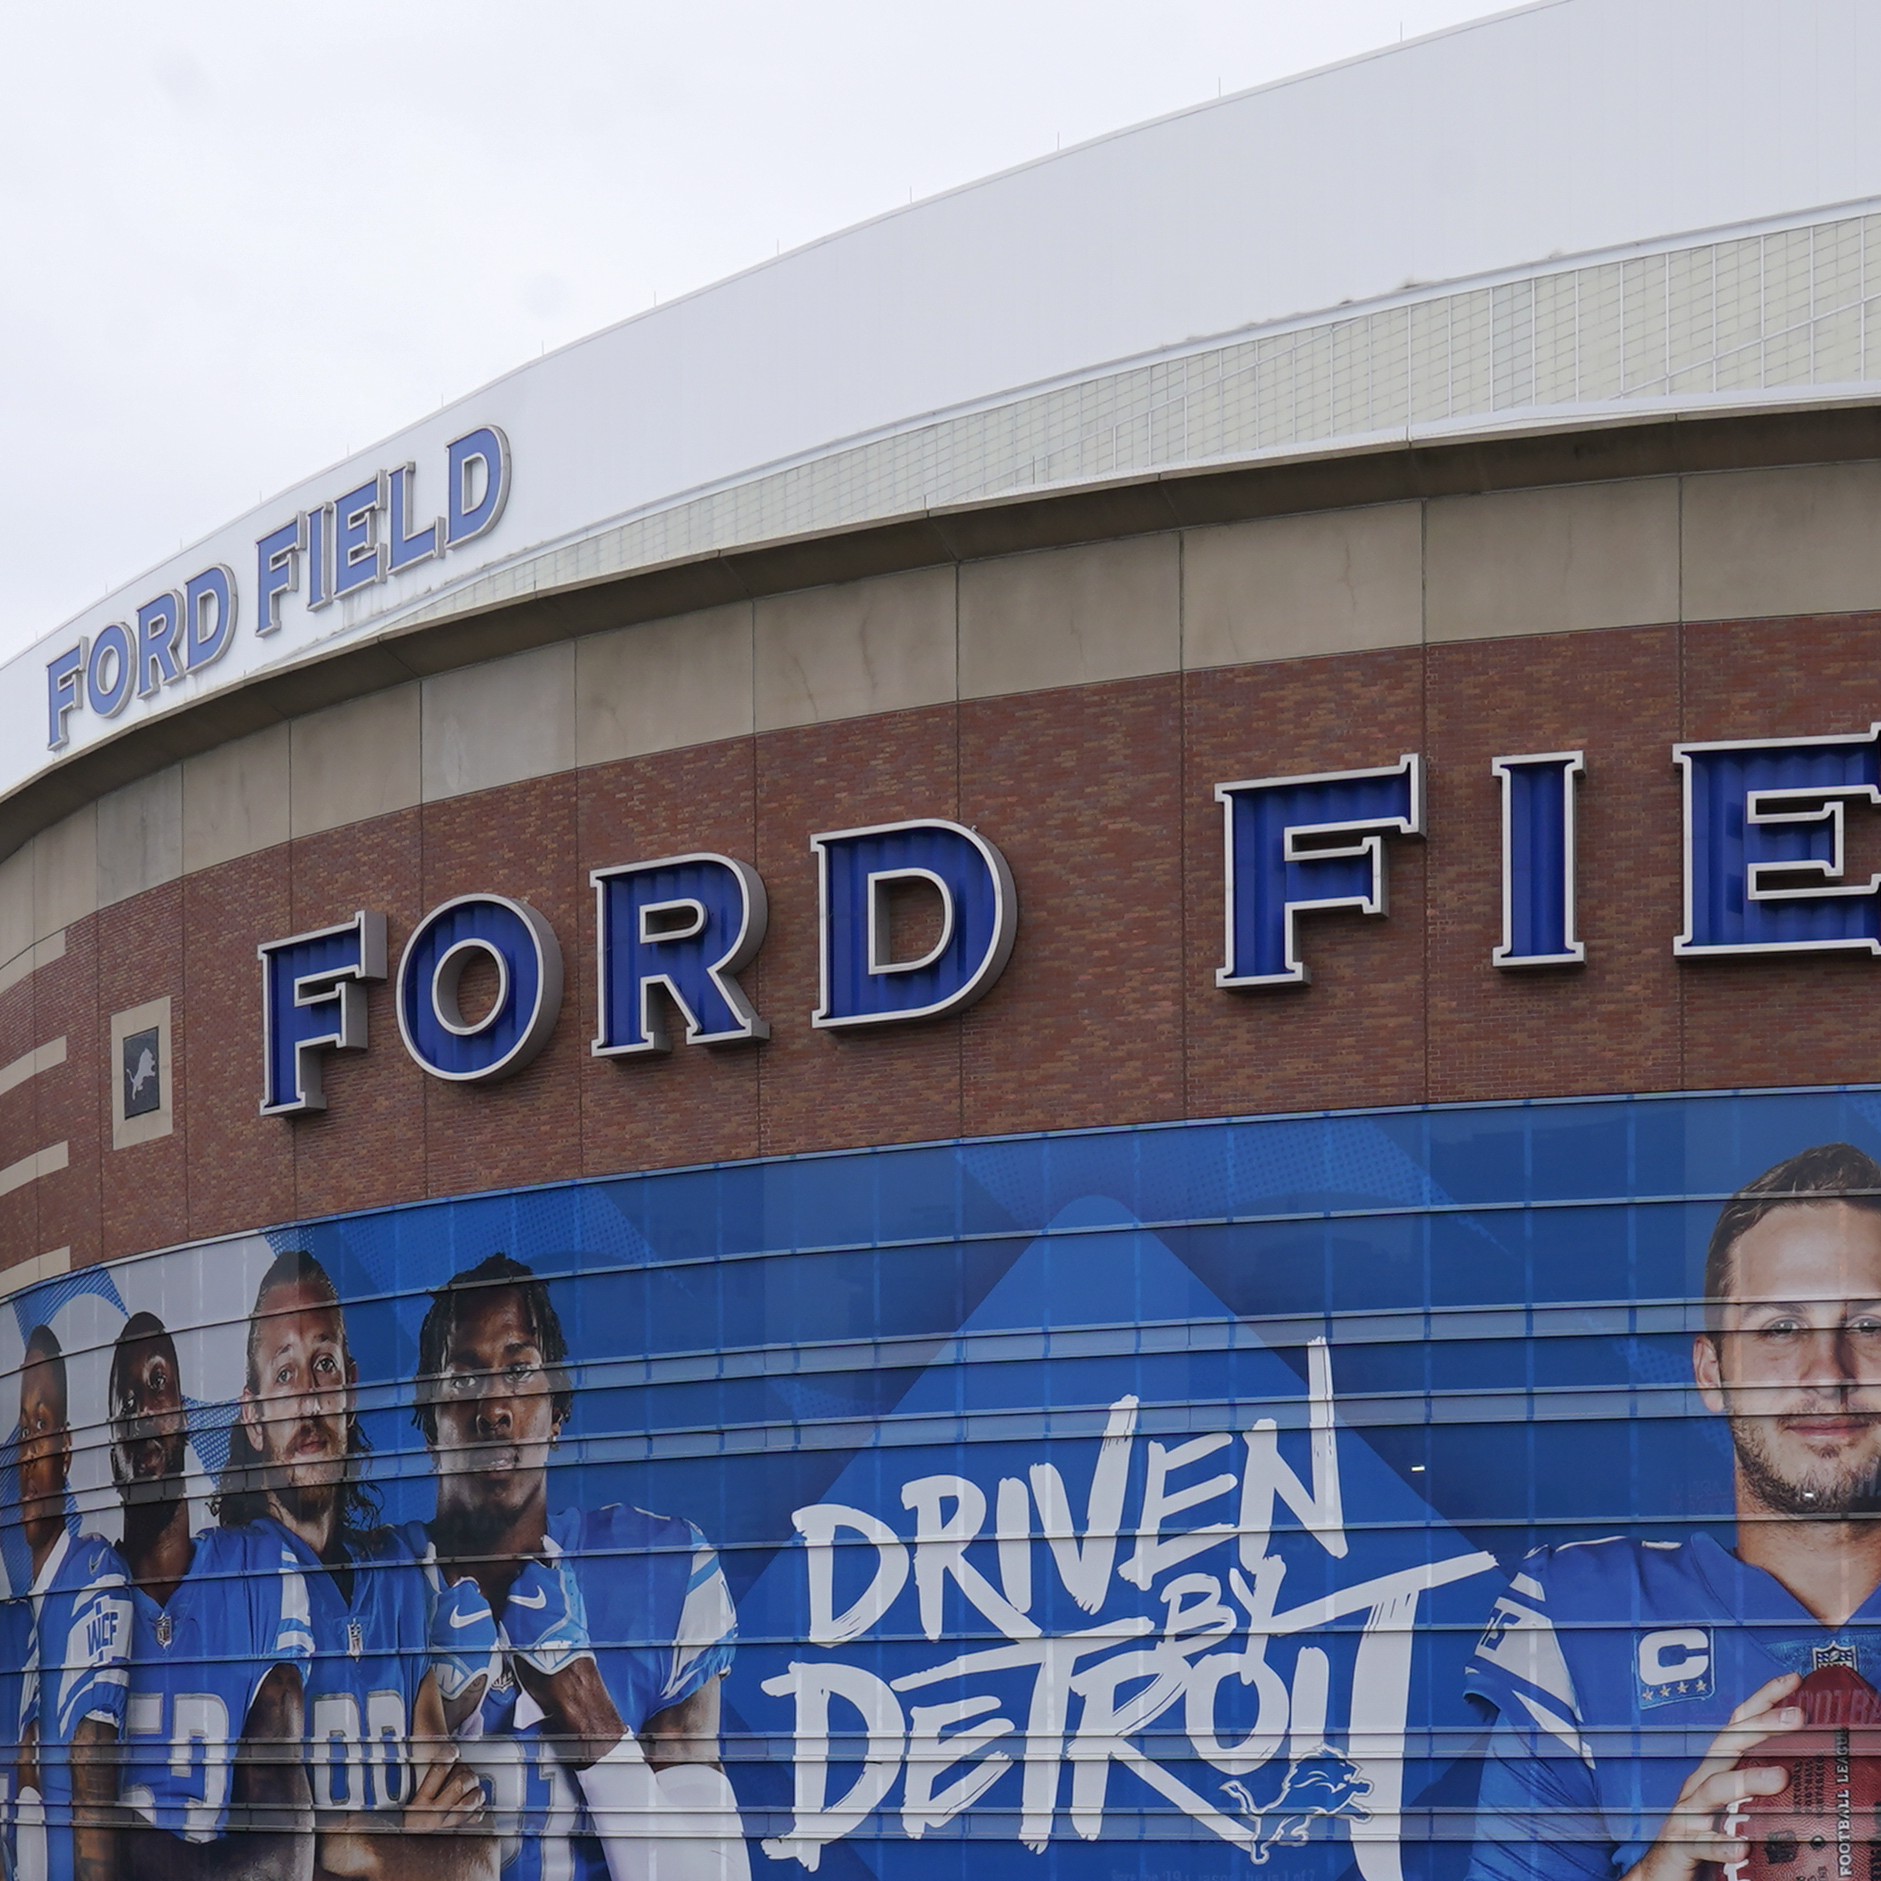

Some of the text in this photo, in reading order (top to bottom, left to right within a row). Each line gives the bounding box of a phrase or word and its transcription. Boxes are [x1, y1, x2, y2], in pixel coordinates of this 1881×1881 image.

[46, 424, 513, 751] FORD FIELD
[257, 817, 1018, 1119] FORD
[790, 1337, 1347, 1648] DRIVEN
[1157, 1553, 1287, 1686] BY
[1636, 1629, 1711, 1684] C
[1837, 1789, 1852, 1877] FOOTBALL
